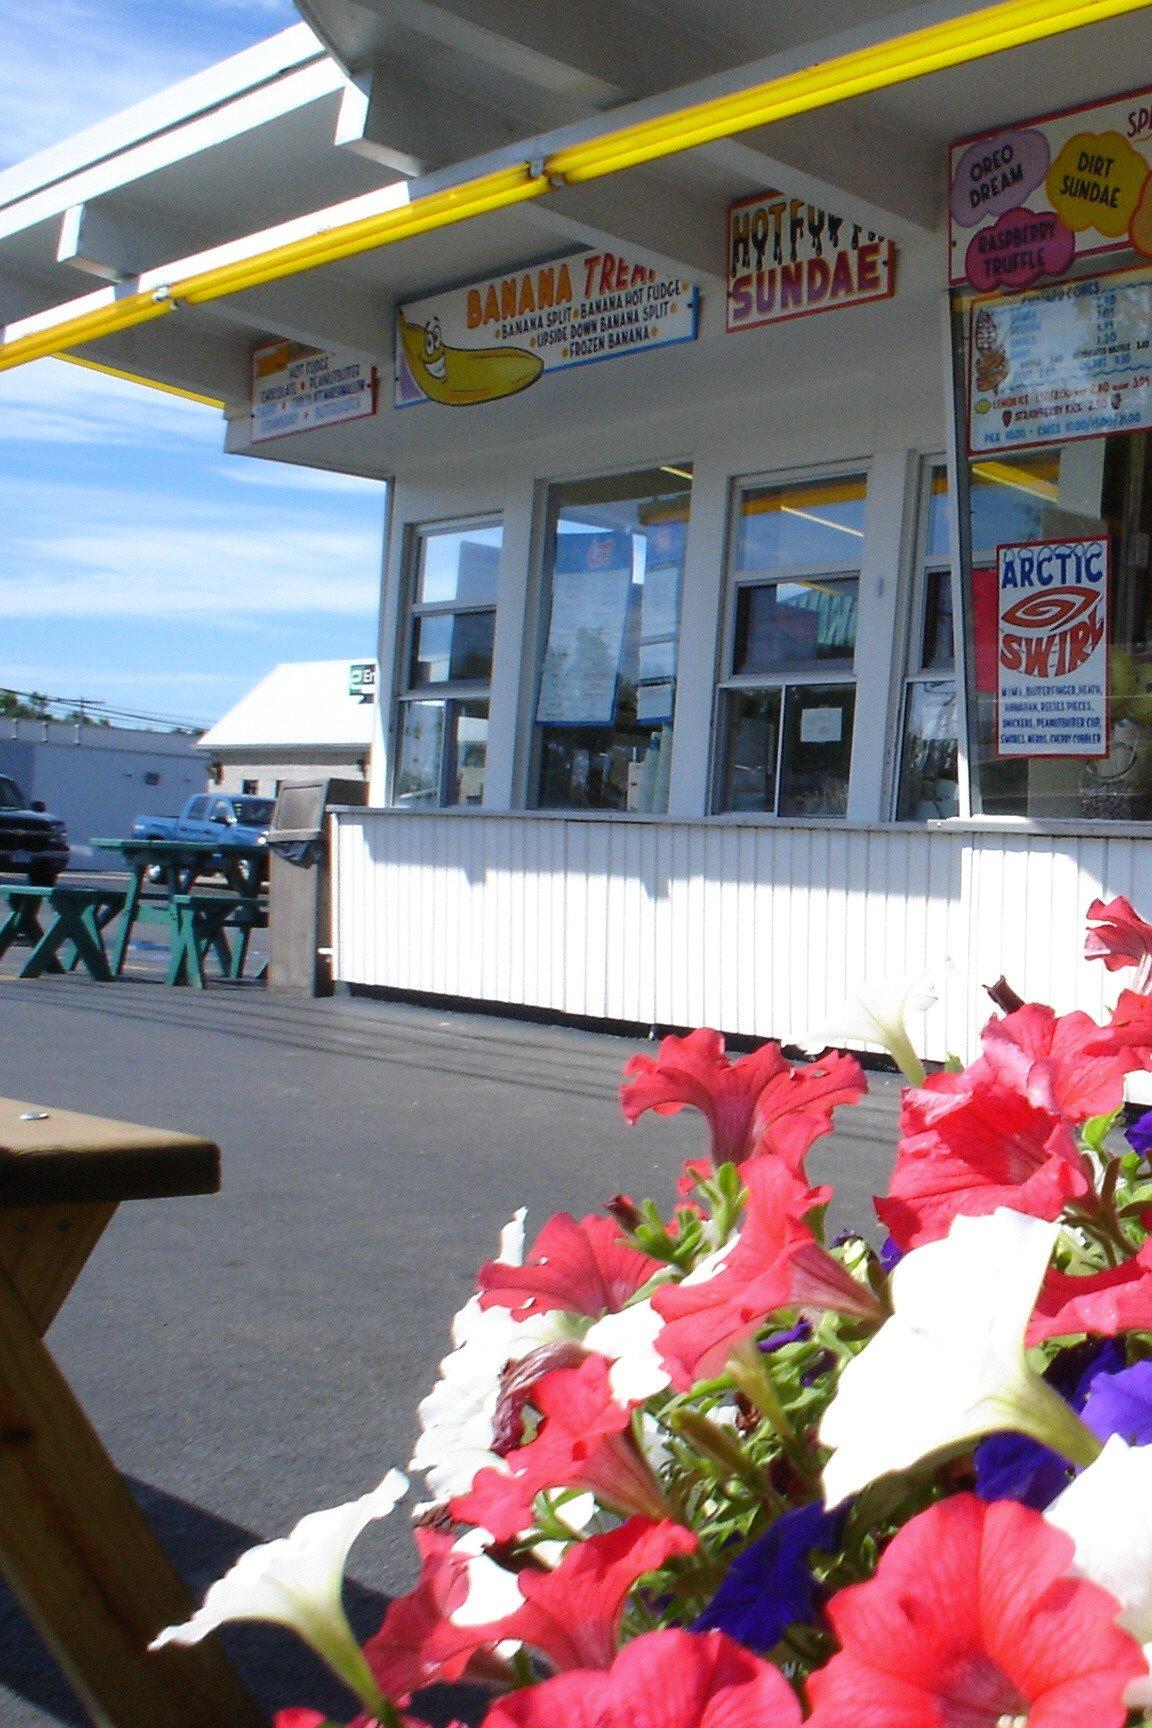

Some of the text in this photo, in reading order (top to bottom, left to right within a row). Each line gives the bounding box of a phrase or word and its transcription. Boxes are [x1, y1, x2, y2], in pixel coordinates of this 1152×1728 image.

[969, 144, 1013, 183] OREO
[1076, 151, 1114, 177] DIRT
[969, 167, 1023, 208] DREAM
[1059, 181, 1119, 209] SUNDAE
[731, 201, 786, 278] HOT
[979, 221, 1056, 254] RASPBERRY
[982, 243, 1045, 274] TRUFFLE
[466, 252, 657, 330] BANANA TREA
[731, 244, 881, 320] SUNDAE
[502, 279, 680, 338] BANANA SPLIT BANANA HOT FUDGE
[537, 300, 669, 347] UPSIDE DOWN BANANA SPLIT
[568, 324, 649, 357] FROZEN BANANA
[1001, 544, 1102, 588] ARCTIC
[1000, 604, 1104, 678] SWIRL
